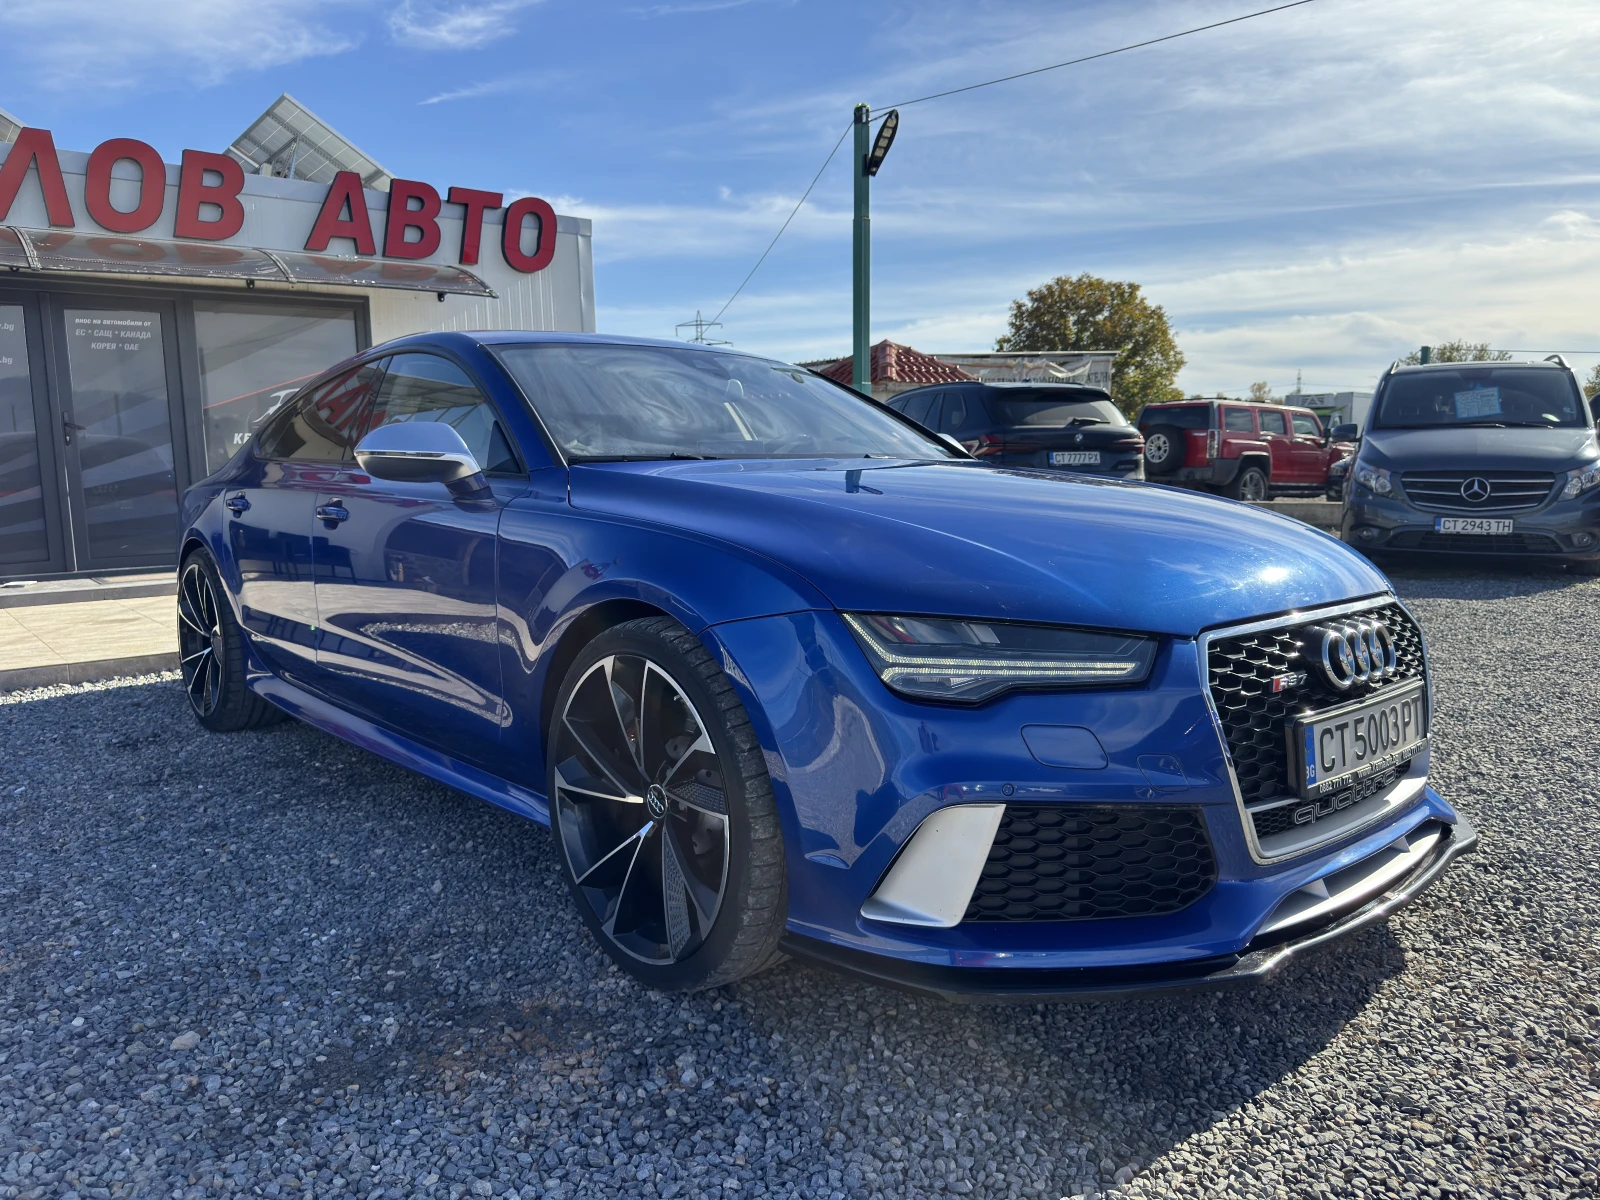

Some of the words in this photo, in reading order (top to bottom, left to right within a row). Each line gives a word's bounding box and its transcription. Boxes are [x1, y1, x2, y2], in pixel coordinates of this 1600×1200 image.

[304, 171, 558, 273] АВТО
[102, 319, 142, 327] автомобили
[75, 328, 86, 336] ЕС
[93, 329, 113, 338] САЩ
[120, 330, 152, 340] КАНАДА
[91, 342, 117, 350] КОРЕЯ
[124, 343, 140, 351] ОАЕ
[1294, 768, 1397, 825] quattro
